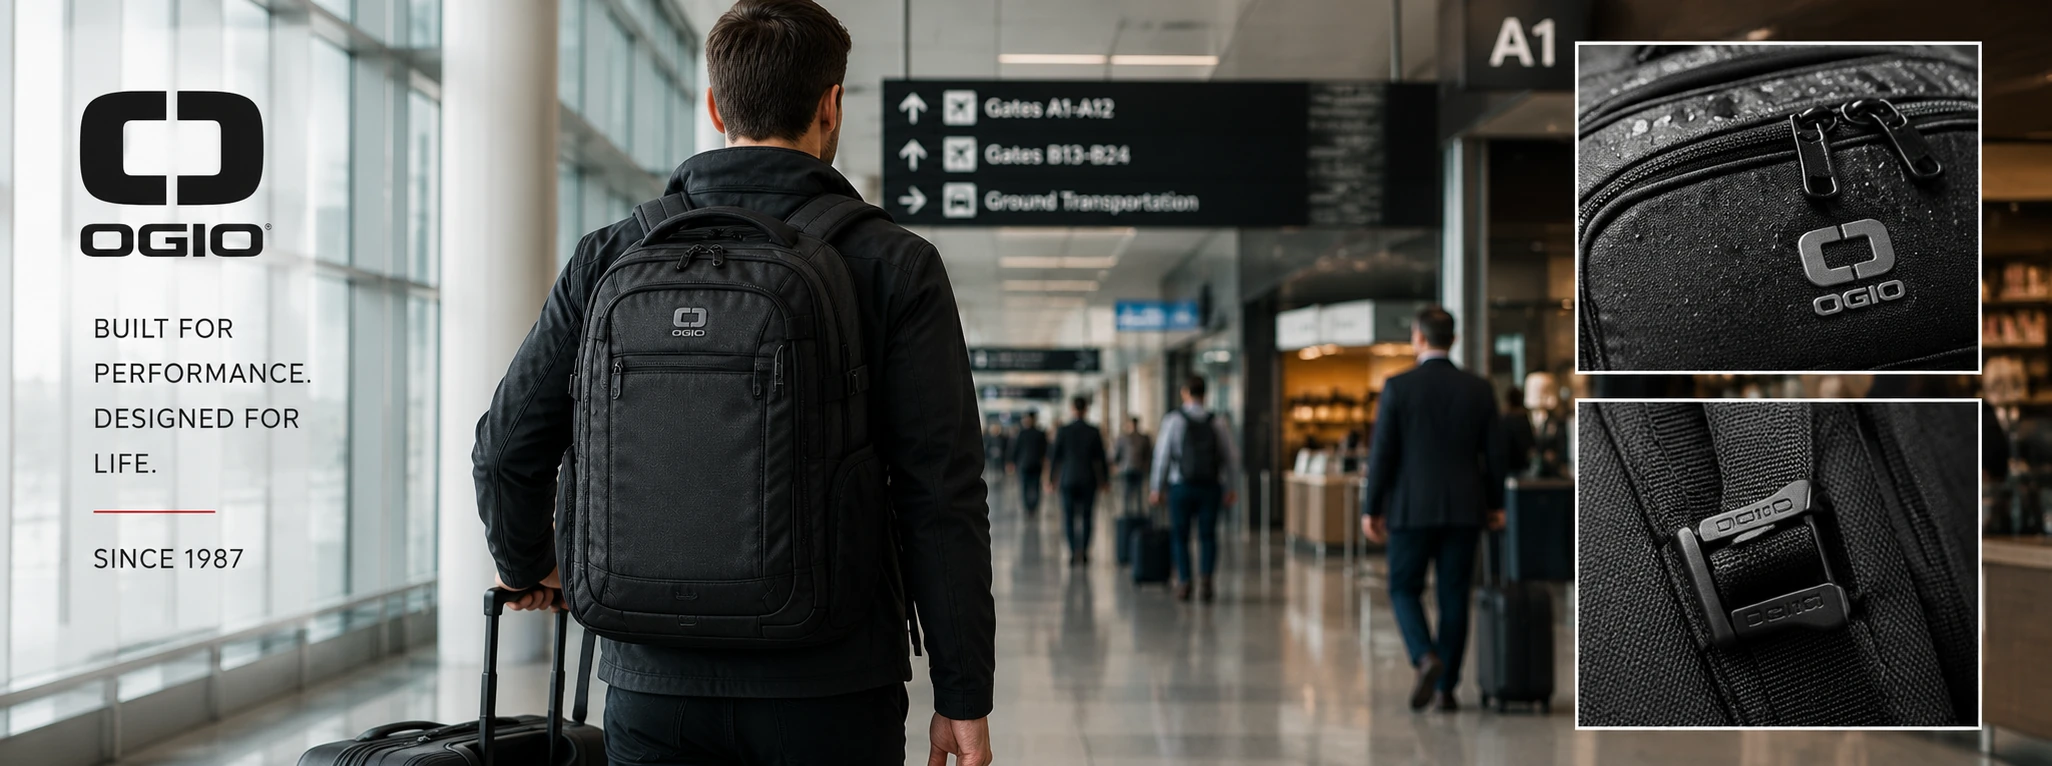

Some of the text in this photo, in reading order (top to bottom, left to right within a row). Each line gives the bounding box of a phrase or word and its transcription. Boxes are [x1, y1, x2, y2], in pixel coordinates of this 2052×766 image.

[1489, 17, 1556, 67] A1
[984, 97, 1115, 119] Gates A1-A12
[984, 144, 1130, 165] Gates B13-B24
[984, 190, 1200, 215] Ground Transportation
[1813, 280, 1905, 316] OGIO
[671, 329, 705, 337] OGIO
